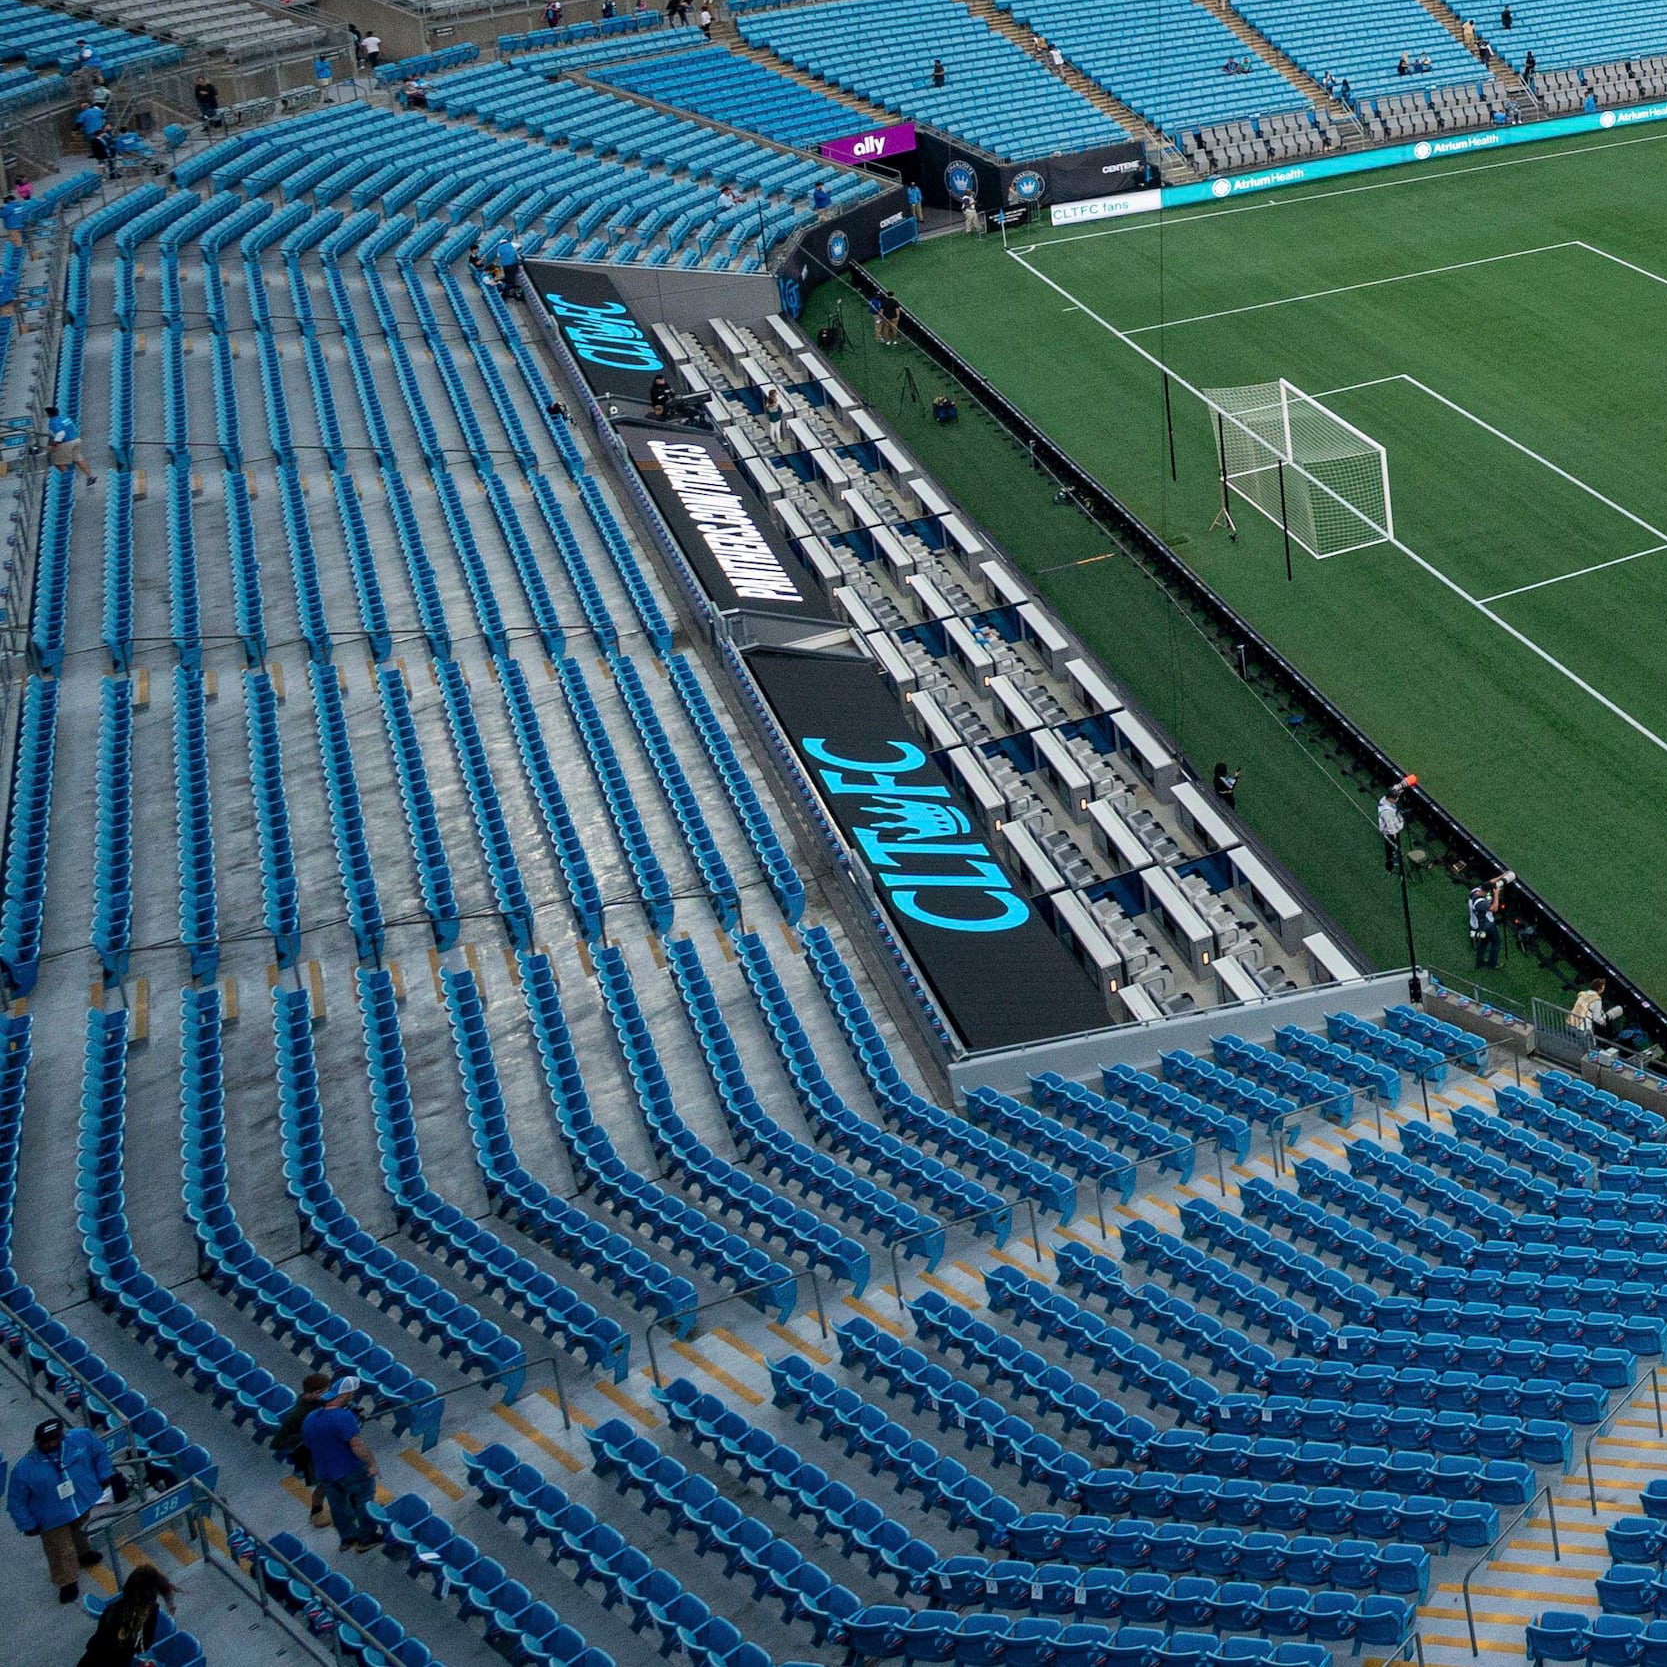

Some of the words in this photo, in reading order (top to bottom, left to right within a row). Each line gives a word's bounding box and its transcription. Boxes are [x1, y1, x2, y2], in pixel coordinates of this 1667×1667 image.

[854, 136, 886, 156] ally
[1434, 138, 1470, 154] Atrium
[1469, 132, 1500, 149] Health
[1234, 174, 1270, 192] Atrium
[1270, 168, 1304, 186] Health
[1053, 202, 1098, 220] CLTFC
[1102, 200, 1129, 213] fans
[153, 1496, 180, 1519] 138
